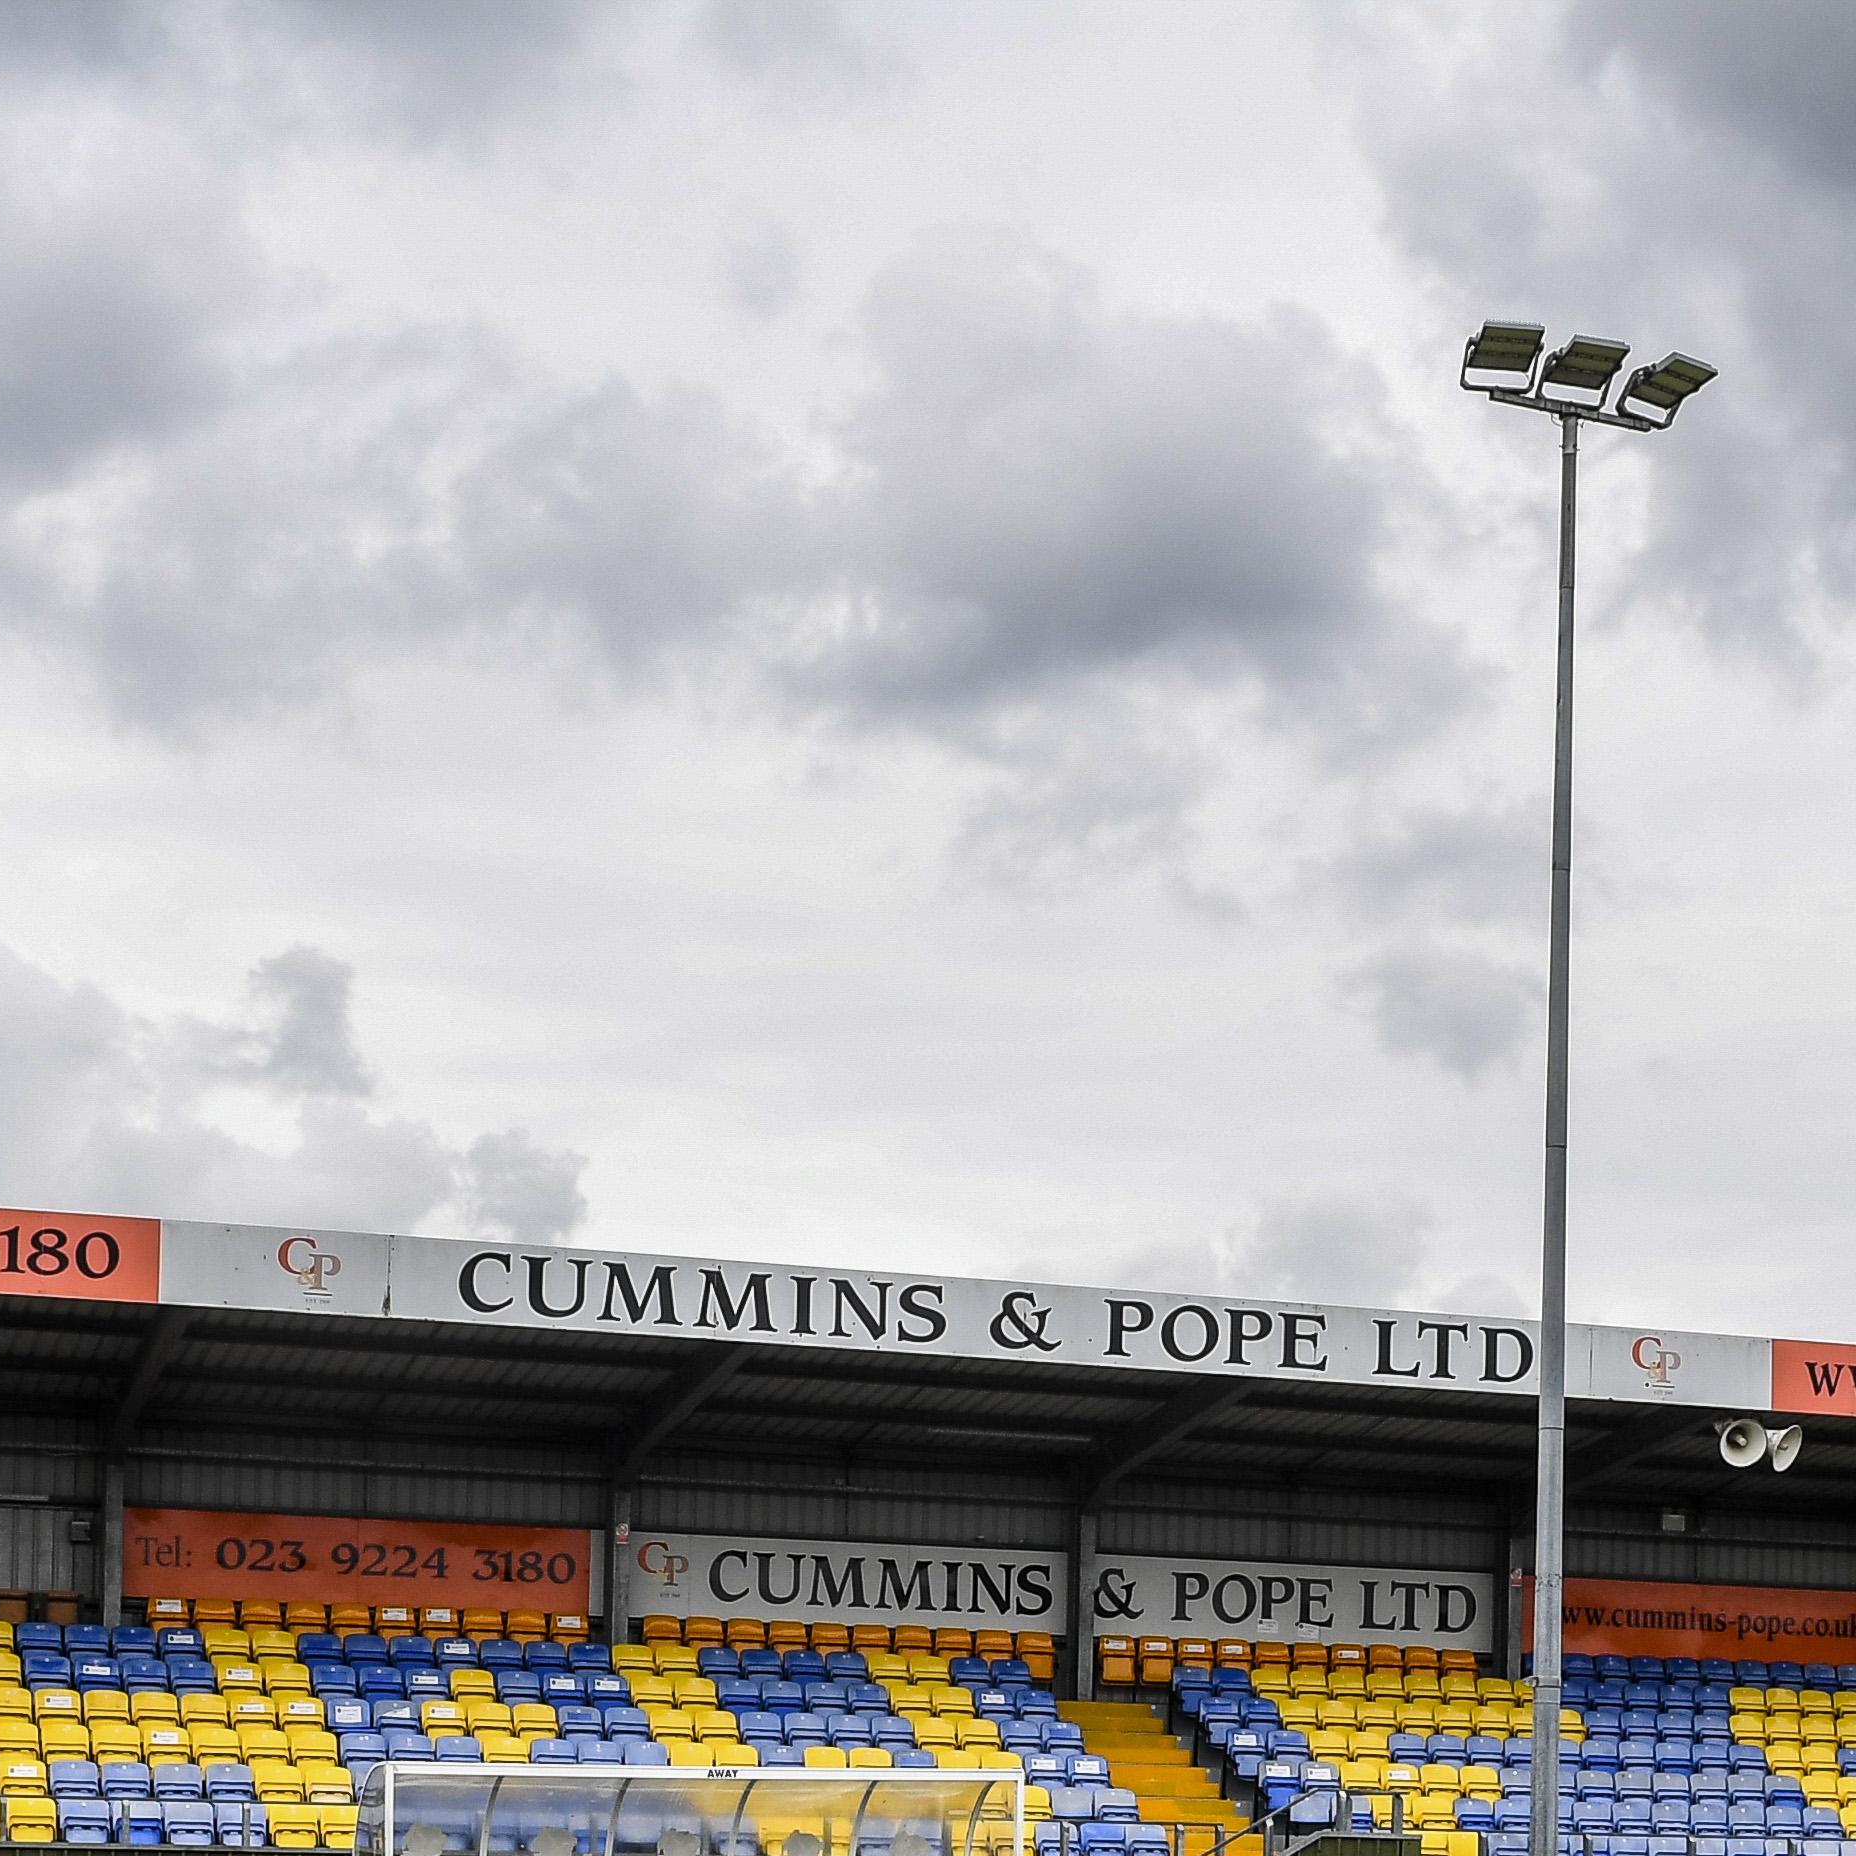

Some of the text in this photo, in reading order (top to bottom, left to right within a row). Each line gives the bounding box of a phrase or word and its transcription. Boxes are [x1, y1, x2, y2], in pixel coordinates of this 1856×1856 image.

[458, 1252, 1535, 1384] CUMMINS & POPE LTD
[135, 1535, 577, 1585] Tel: 023 9224 3180
[708, 1549, 1477, 1634] CUMMINS & POPE LTD
[707, 1769, 739, 1778] AWAY
